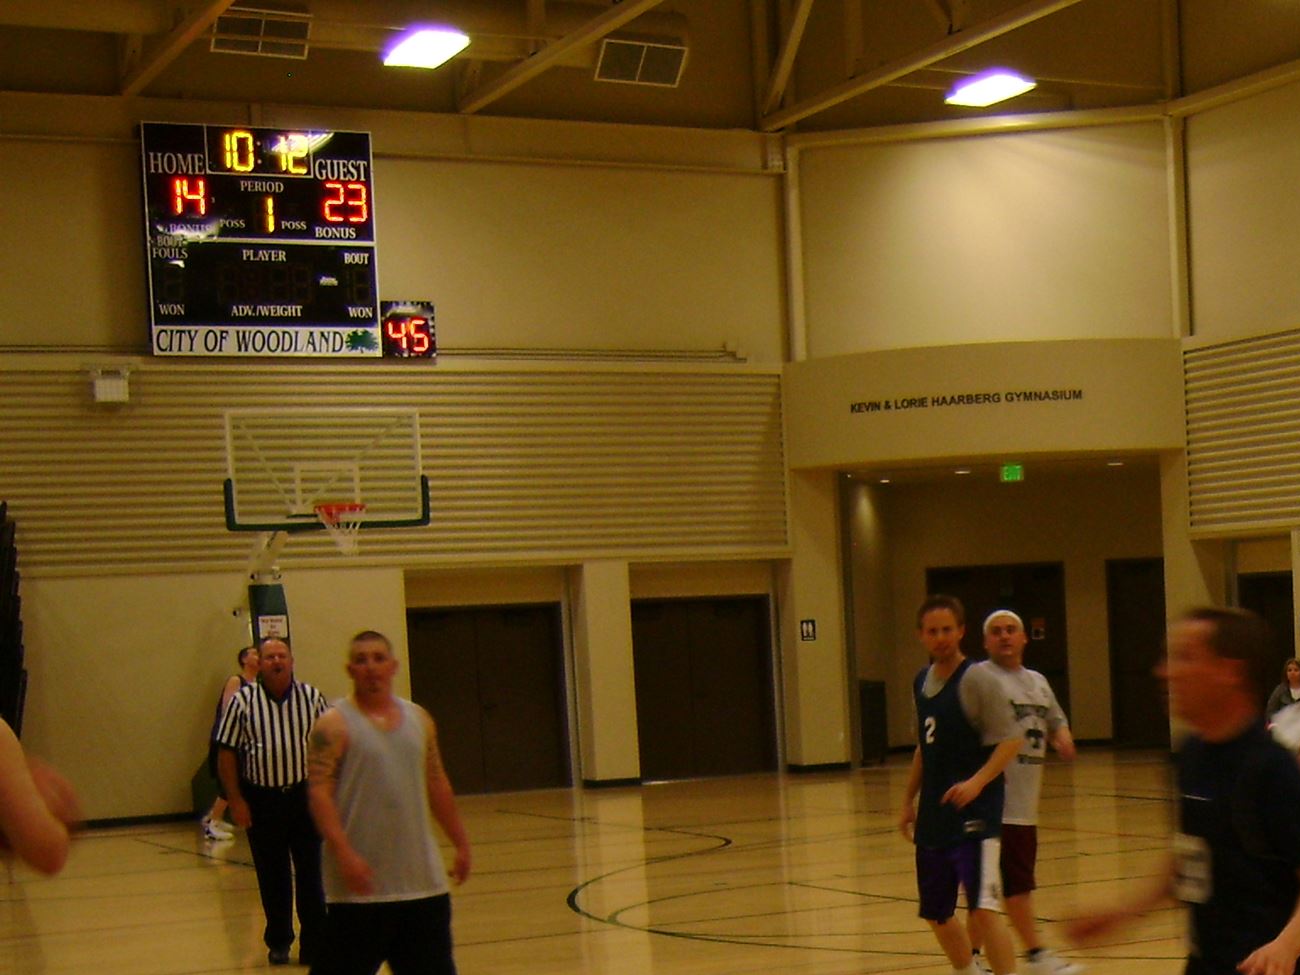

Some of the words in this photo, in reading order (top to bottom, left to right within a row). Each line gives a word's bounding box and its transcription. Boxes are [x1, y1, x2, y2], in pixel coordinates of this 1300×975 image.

[149, 152, 205, 175] HOME
[315, 159, 367, 181] GUEST
[240, 181, 284, 193] PERIOD
[175, 179, 205, 215] 14
[324, 183, 367, 222] 23
[267, 197, 274, 232] 1
[220, 219, 246, 228] POSS
[281, 221, 307, 230] POSS
[315, 227, 356, 239] BONUS
[152, 247, 188, 259] FOULS
[242, 250, 287, 262] PLAYER
[344, 253, 369, 264] BOUT
[159, 304, 185, 315] WON
[348, 307, 373, 318] WON
[156, 329, 198, 352] CITY
[204, 330, 229, 352] OF
[235, 330, 344, 353] WOODLAND
[388, 320, 429, 351] 45
[850, 401, 881, 414] KEVIN
[884, 400, 892, 410] &
[931, 393, 1001, 407] HAARBERG
[1005, 390, 1083, 402] GYMNASIUM
[924, 717, 937, 744] 2
